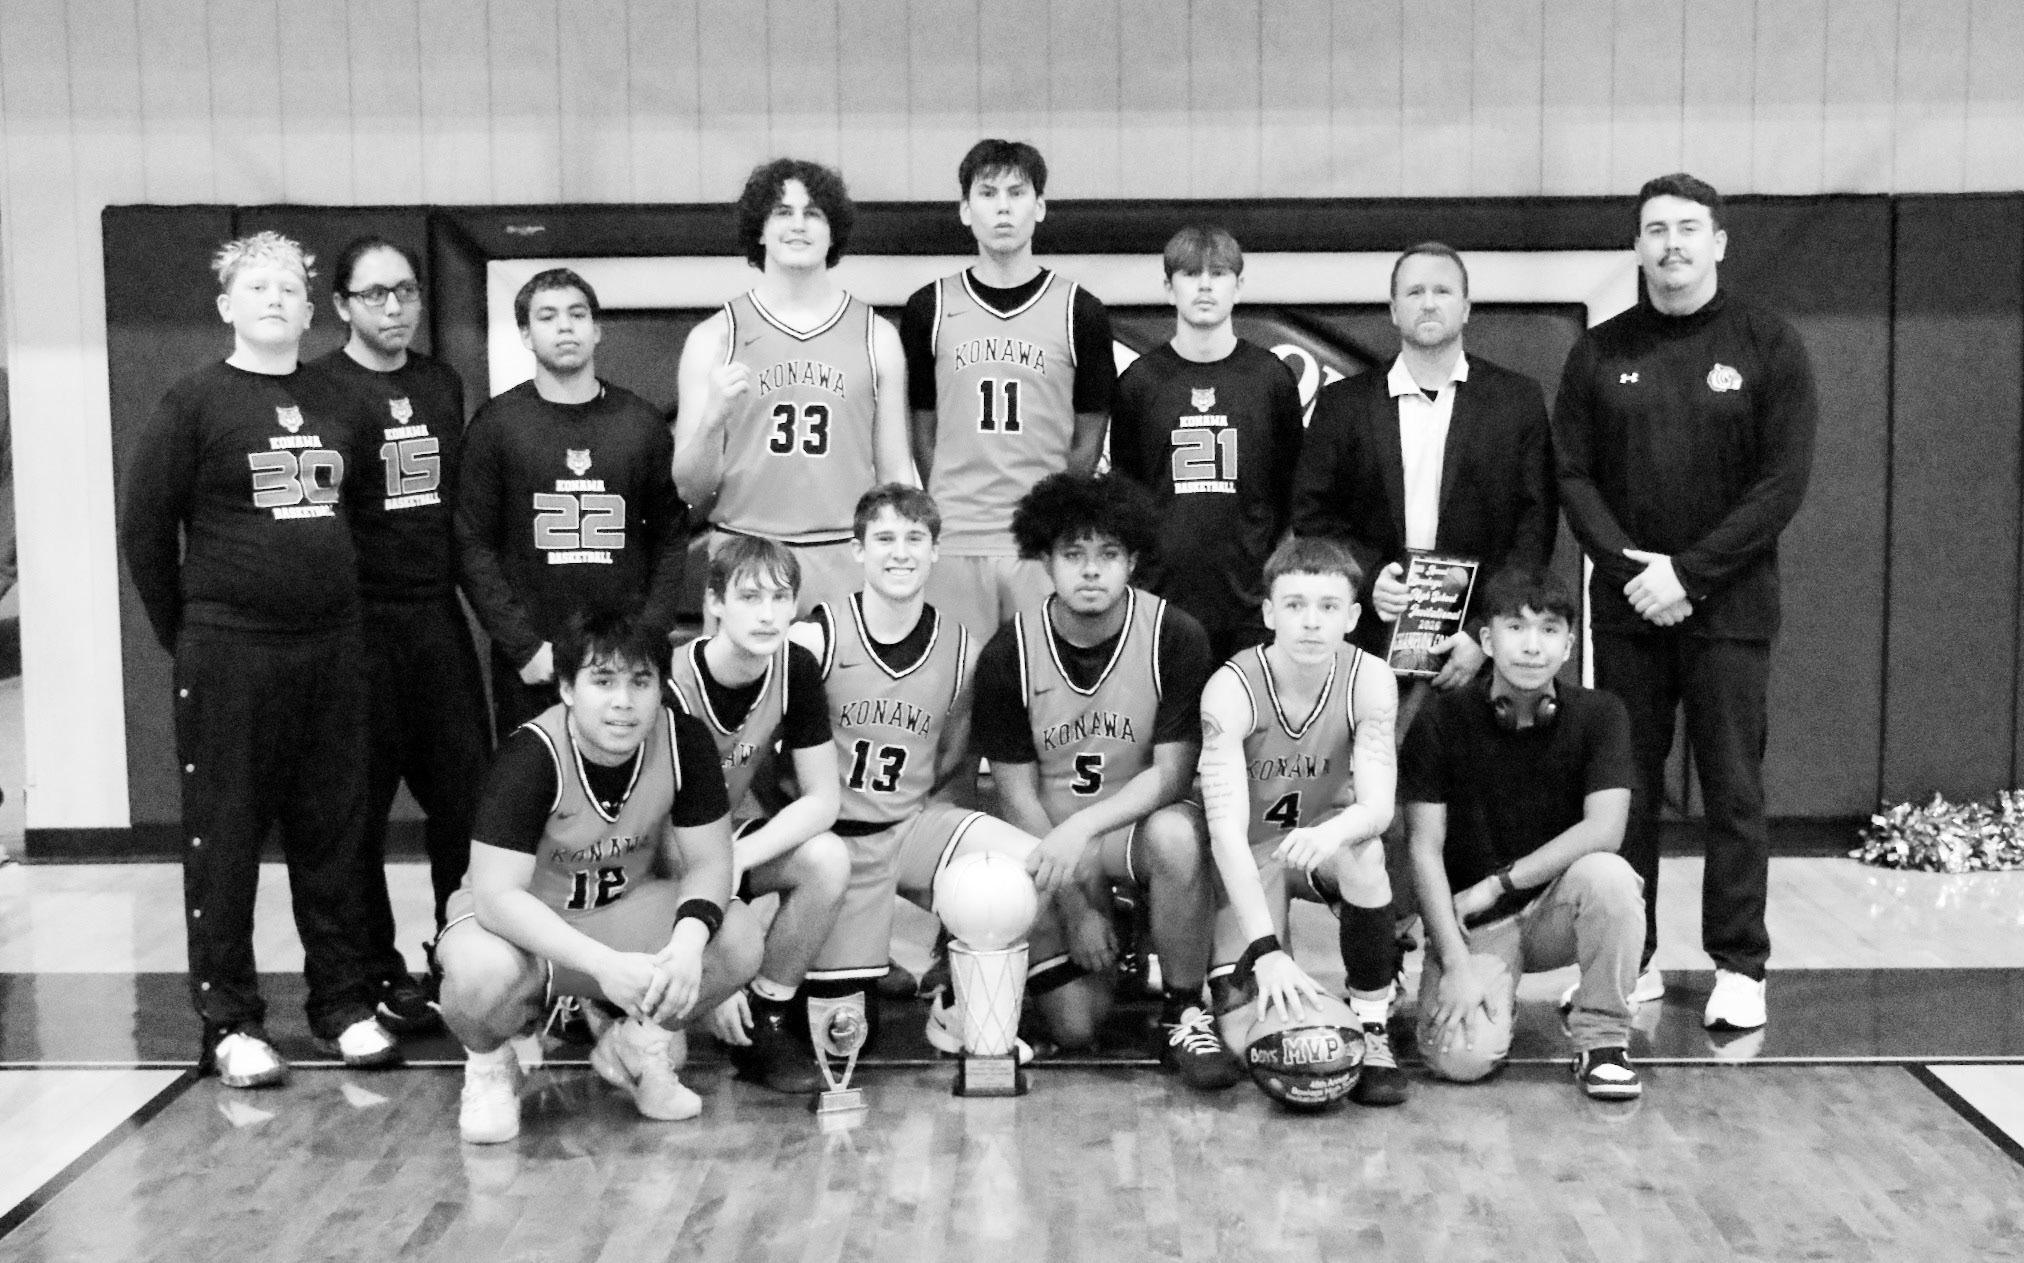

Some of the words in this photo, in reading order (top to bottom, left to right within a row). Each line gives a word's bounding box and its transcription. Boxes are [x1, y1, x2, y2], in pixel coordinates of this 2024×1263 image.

[955, 337, 1047, 376] KONAWA
[759, 360, 846, 400] KONAWA
[977, 378, 1022, 434] 11
[1179, 415, 1229, 428] KONAWA
[269, 435, 322, 450] KONAWA
[384, 424, 429, 440] KONAWA
[767, 401, 832, 458] 33
[380, 437, 440, 496] 15
[1171, 428, 1238, 481] 21
[248, 450, 344, 508] 30
[555, 479, 606, 492] KONAWA
[1174, 481, 1237, 494] BASKETBALL
[384, 492, 441, 510] BASKETBALL
[533, 492, 626, 549] 22
[547, 551, 614, 564] BASKETBALL
[839, 699, 931, 739] KONAWA
[1043, 710, 1136, 752] KONAWA
[846, 739, 910, 794] 13
[1069, 752, 1105, 797] 5
[1263, 790, 1303, 830] 4
[564, 866, 628, 910] 12
[1281, 1036, 1340, 1065] MVP
